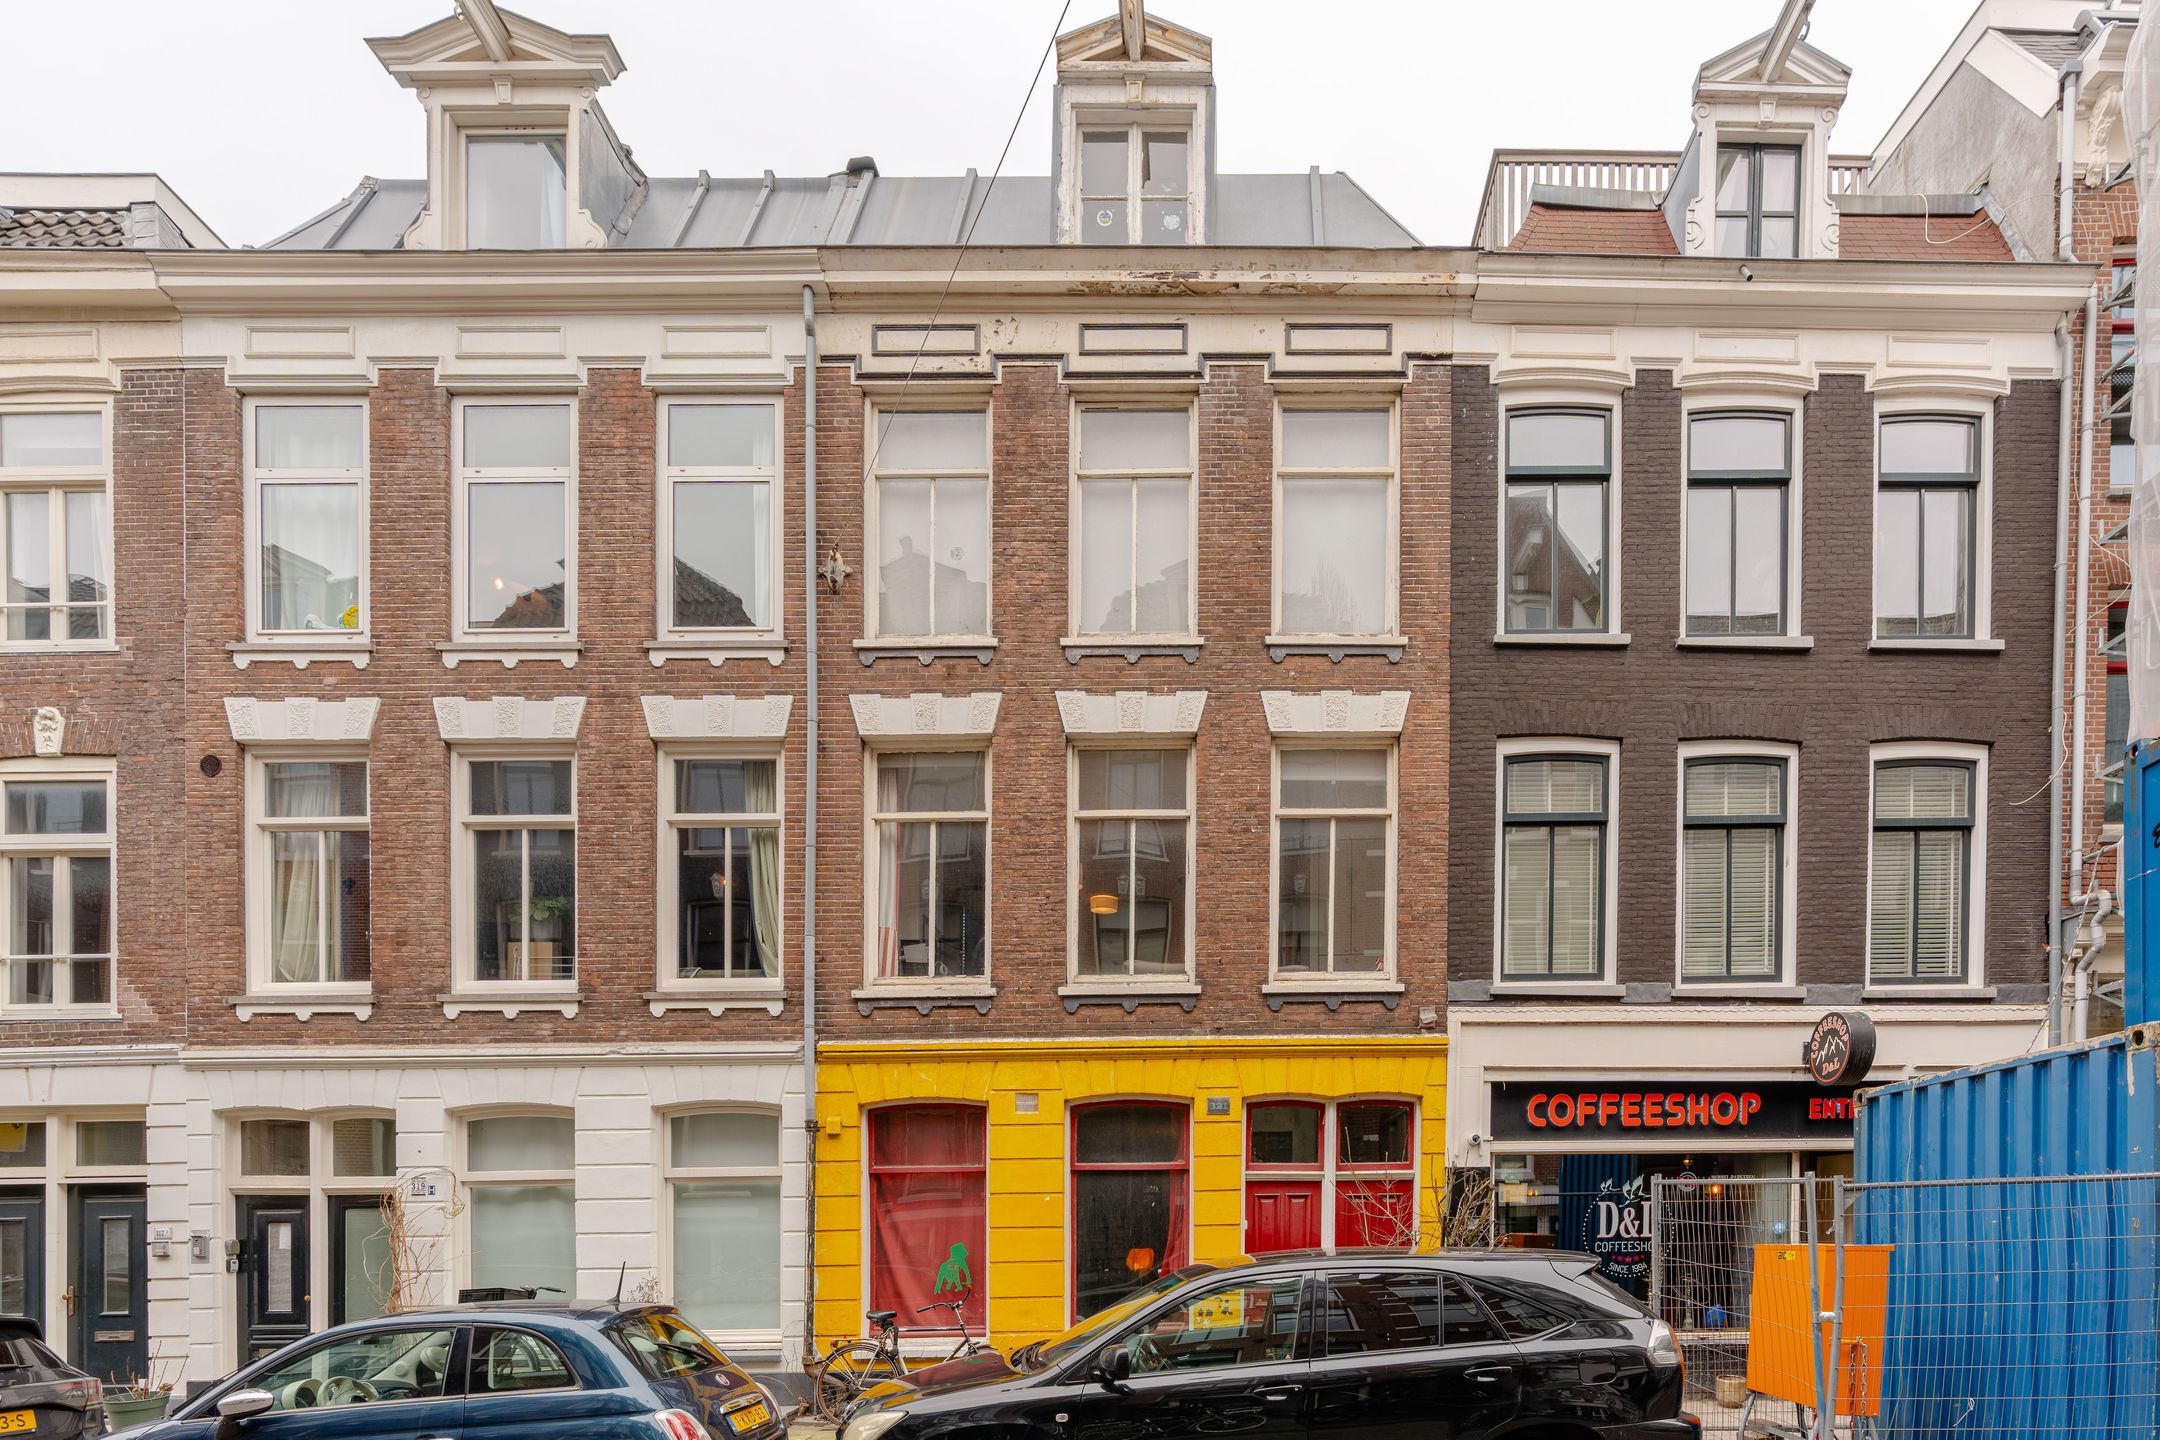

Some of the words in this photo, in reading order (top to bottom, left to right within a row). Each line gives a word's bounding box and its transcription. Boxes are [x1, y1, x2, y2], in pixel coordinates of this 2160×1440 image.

[1810, 1015, 1849, 1058] COFFEESHOP
[1822, 1057, 1840, 1076] D&L
[1527, 1092, 1761, 1127] COFFEESHOP
[411, 1182, 426, 1191] 319
[1595, 1241, 1653, 1252] COFFEESHO
[1608, 1261, 1629, 1273] SINCE
[1632, 1261, 1648, 1273] 1994
